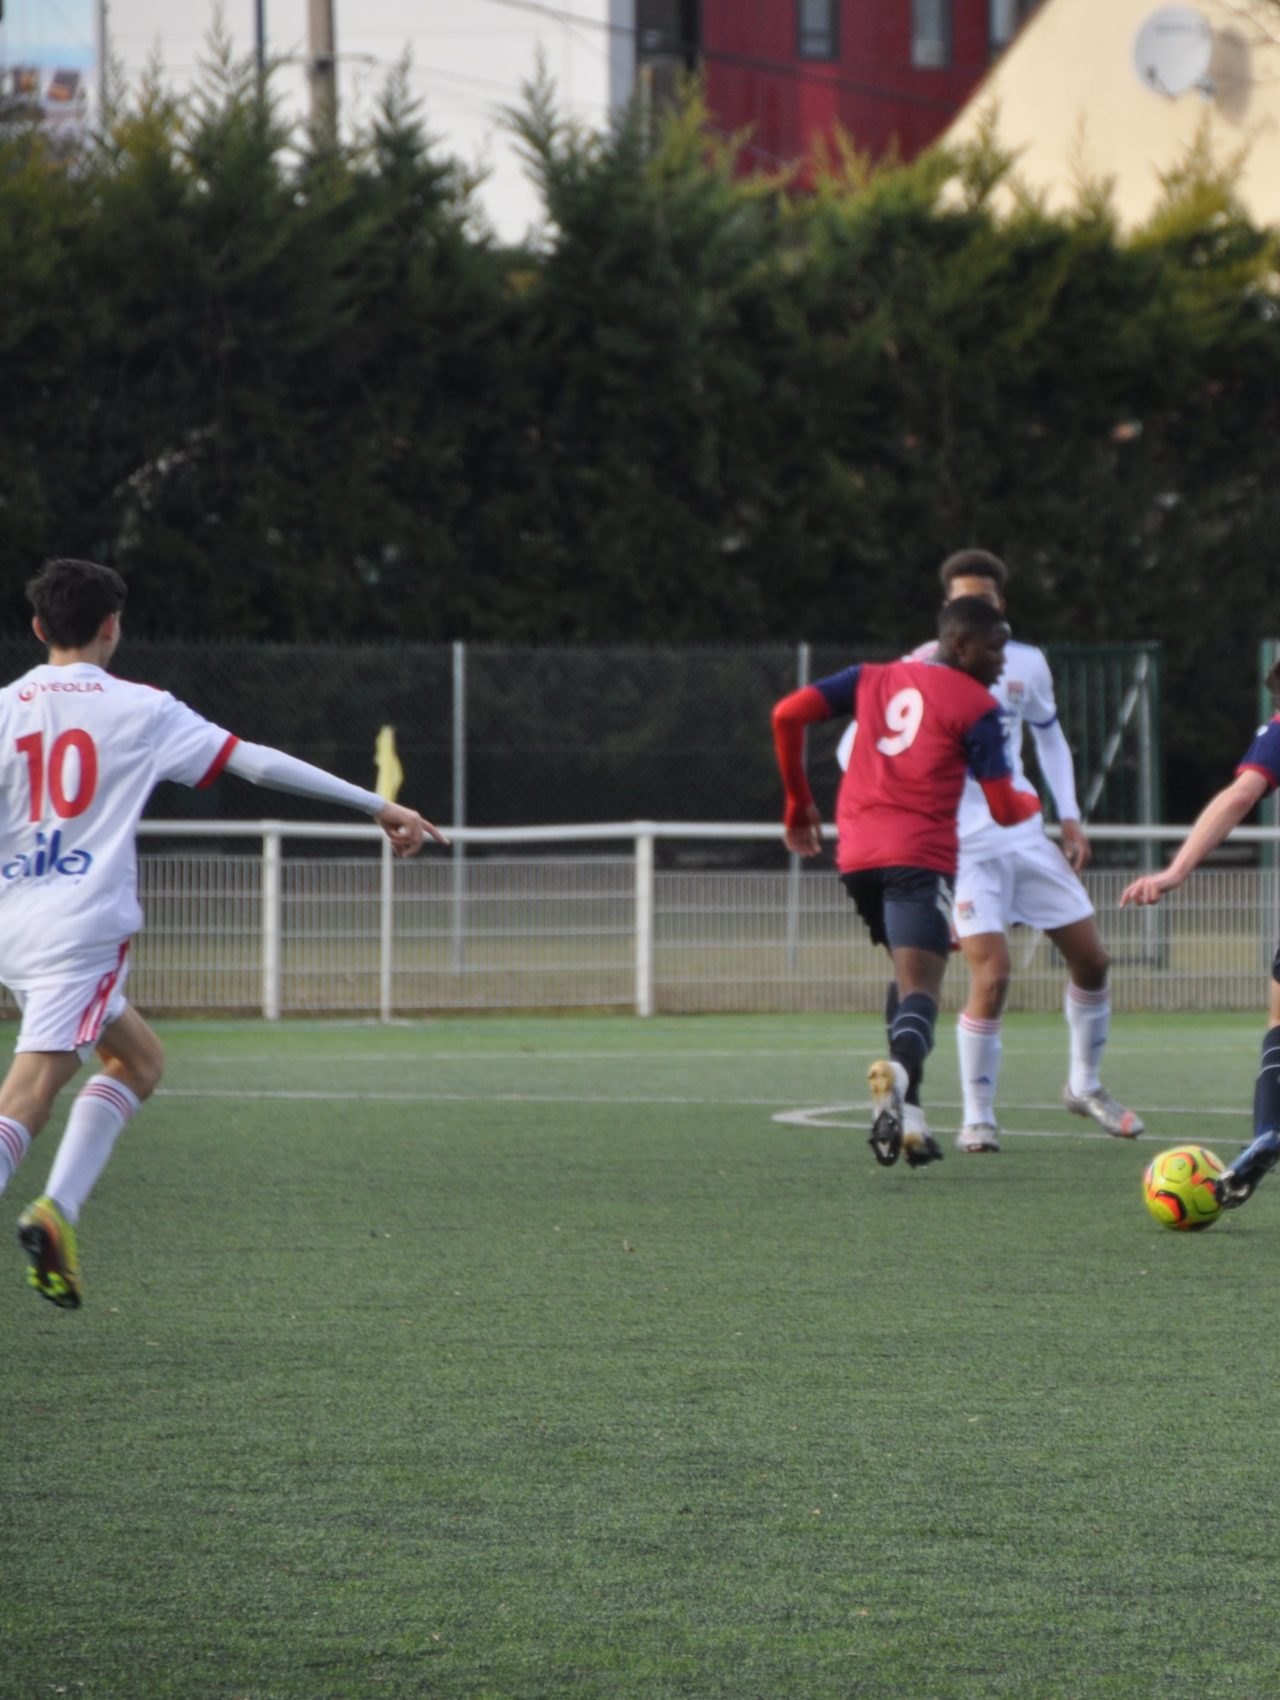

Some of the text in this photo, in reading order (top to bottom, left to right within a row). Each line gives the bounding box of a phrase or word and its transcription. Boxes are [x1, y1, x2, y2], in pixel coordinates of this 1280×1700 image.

[40, 682, 104, 693] VEOLIA
[876, 687, 924, 757] 9
[15, 728, 98, 823] 10
